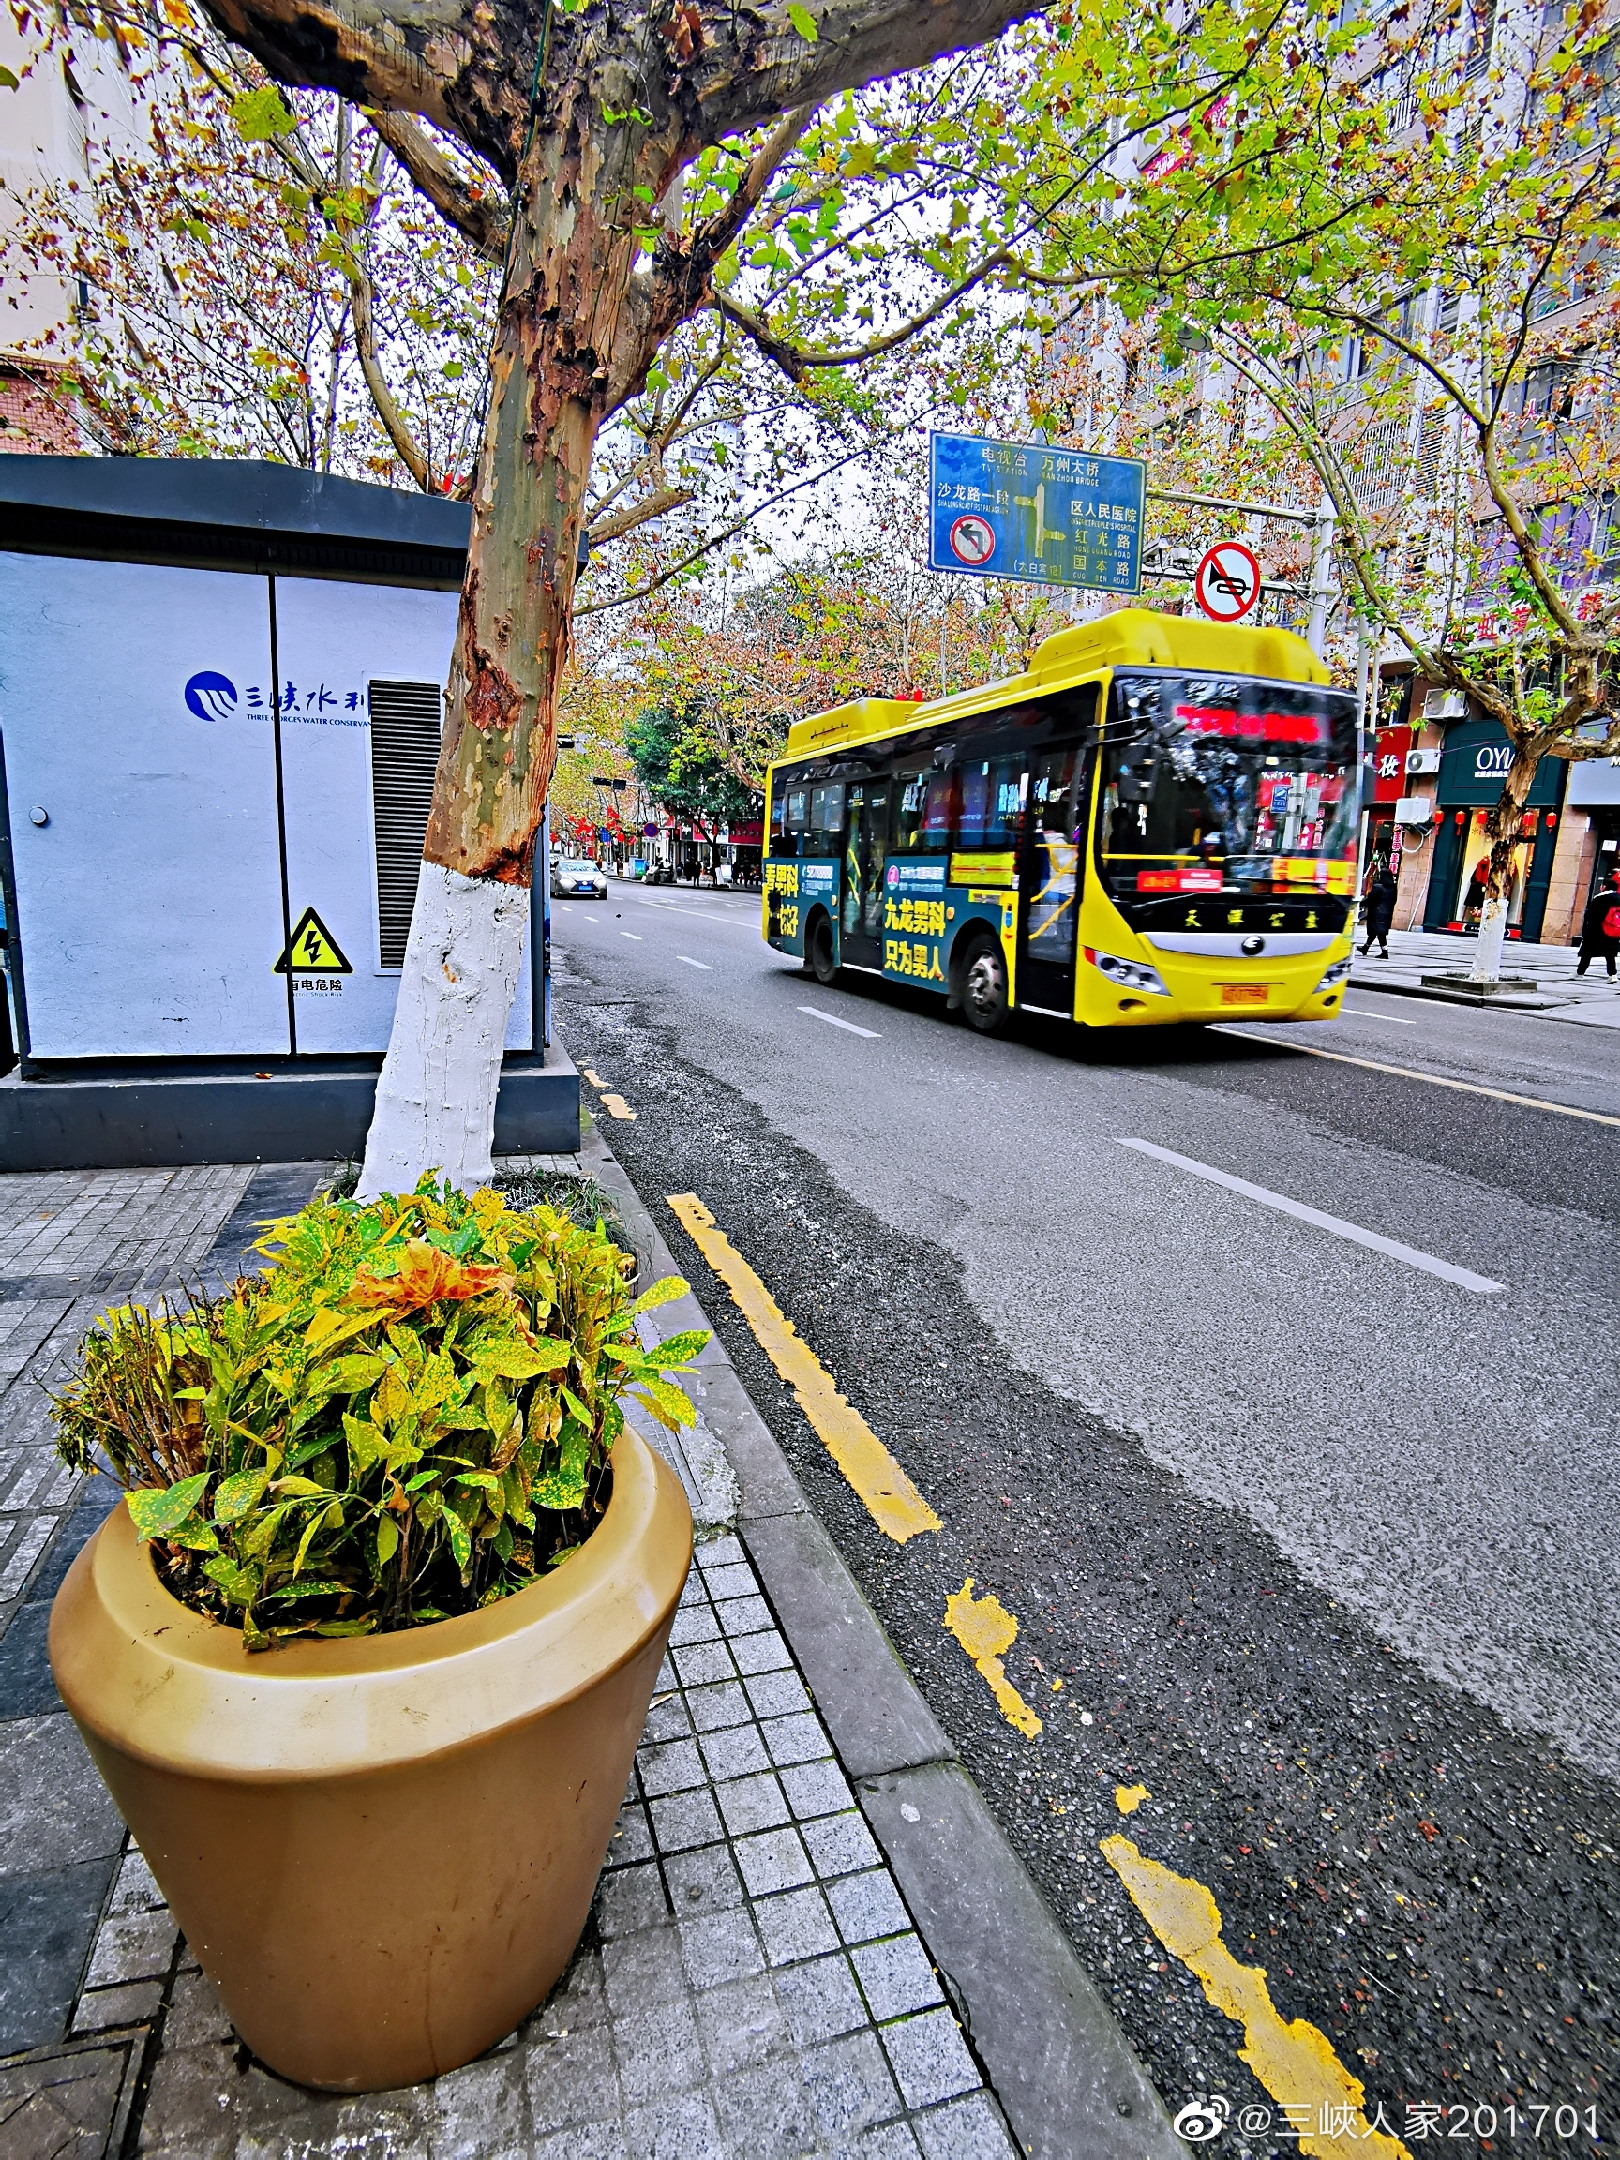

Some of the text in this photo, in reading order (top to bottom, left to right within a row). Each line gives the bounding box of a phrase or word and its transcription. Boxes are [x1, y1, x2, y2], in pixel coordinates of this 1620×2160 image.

[981, 447, 1099, 477] 电视台 万州大桥
[1075, 476, 1099, 488] BRIDGE
[937, 482, 1009, 506] 沙龙路一段
[1071, 500, 1137, 522] 区人民医院
[1075, 529, 1130, 549] 红光路
[1113, 549, 1131, 559] ROAD
[1073, 555, 1130, 576] 国本路
[1113, 576, 1129, 585] ROAD
[246, 713, 269, 721] THREE
[303, 717, 328, 725] WATER
[884, 896, 946, 938] 九龙男科
[884, 939, 945, 982] 只为男人
